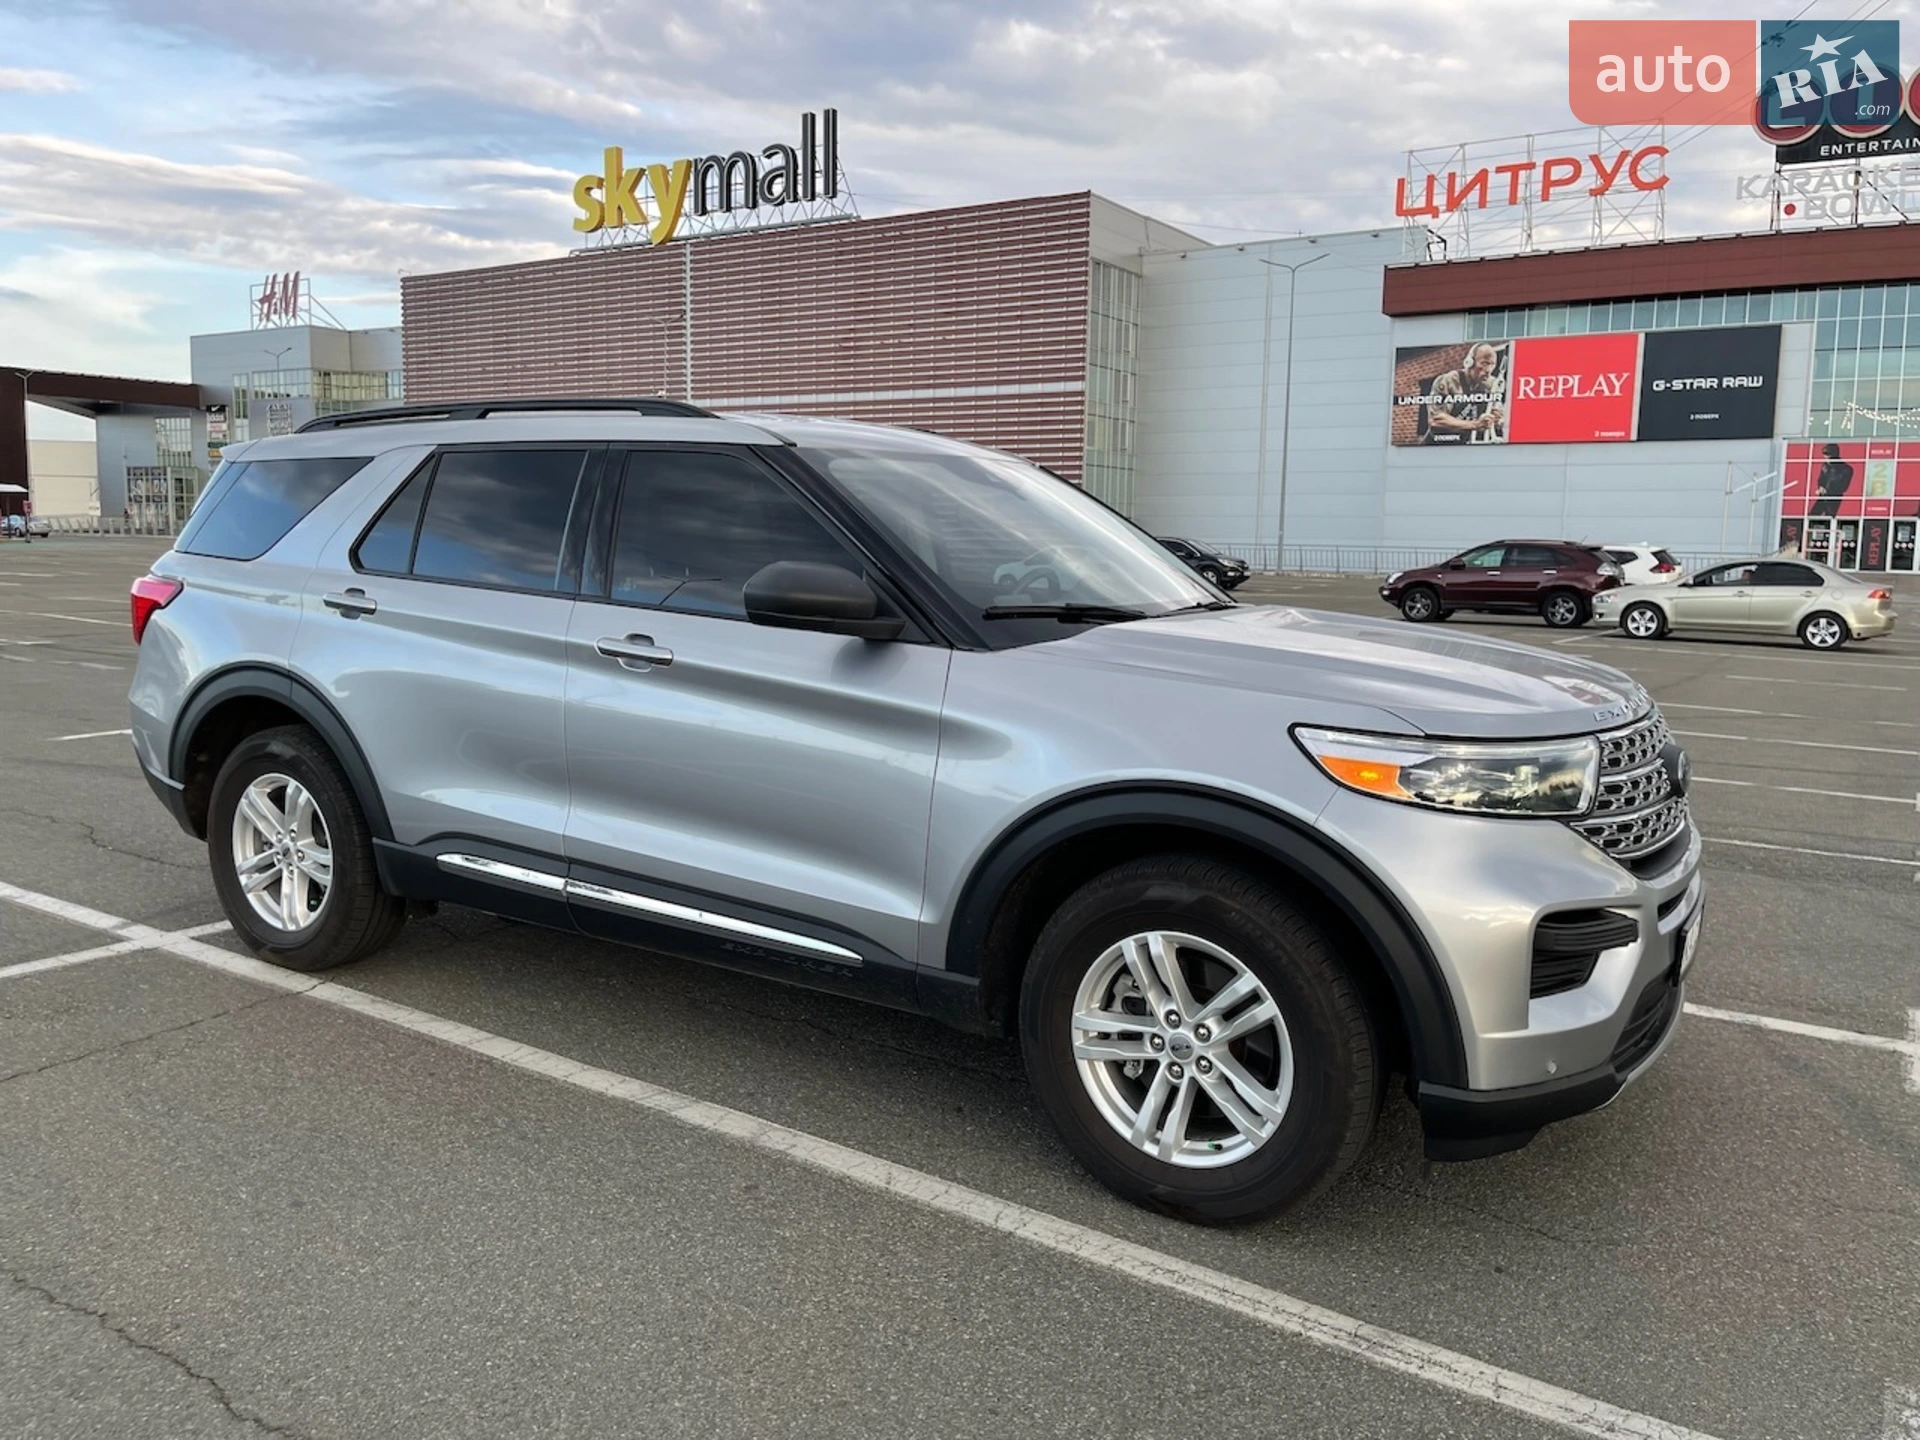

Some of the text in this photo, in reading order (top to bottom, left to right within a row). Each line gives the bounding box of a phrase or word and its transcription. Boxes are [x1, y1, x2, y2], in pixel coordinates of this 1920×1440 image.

[572, 107, 838, 246] skymall
[1394, 144, 1671, 219] ЦИТРУС
[1736, 160, 1920, 201] KARAOKE
[1397, 392, 1504, 406] UNDER ARMOUR
[1516, 372, 1631, 400] REPLAY
[1722, 375, 1763, 389] RAW
